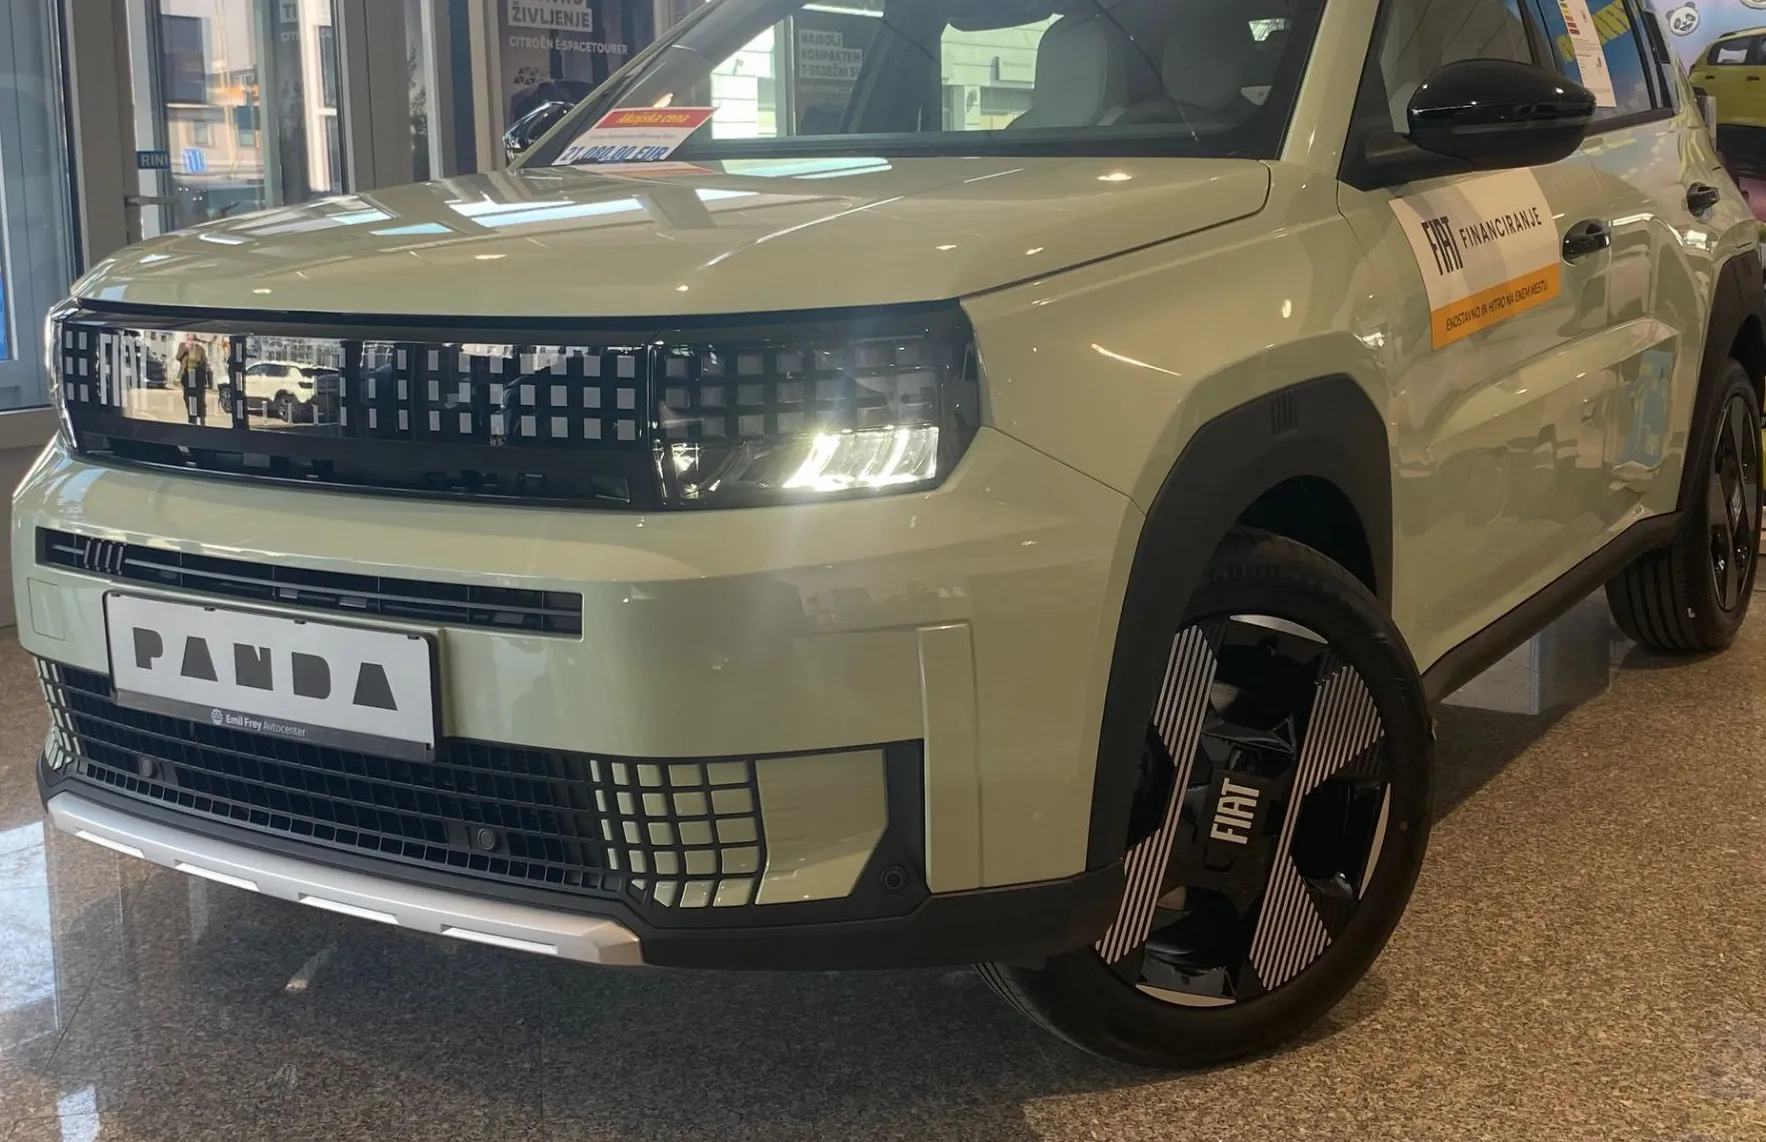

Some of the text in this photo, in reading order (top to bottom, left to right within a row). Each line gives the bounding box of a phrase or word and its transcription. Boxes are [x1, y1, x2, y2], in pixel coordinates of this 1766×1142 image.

[512, 1, 590, 28] ŽIVLJENJE
[509, 34, 553, 50] CITROËN
[141, 153, 168, 167] RINI
[635, 147, 669, 160] EUR
[1421, 207, 1542, 275] FIAT FINANCIRANJE
[1446, 308, 1480, 331] ENOSTAVNO
[1481, 305, 1489, 316] IN
[1488, 296, 1506, 312] HITRO
[1506, 294, 1515, 307] NA
[1515, 286, 1530, 303] ENEM
[100, 332, 148, 411] FIAT
[133, 627, 398, 711] PANDA
[225, 714, 307, 737] Emil Frey Avtocenter
[1210, 777, 1260, 844] FIAT
